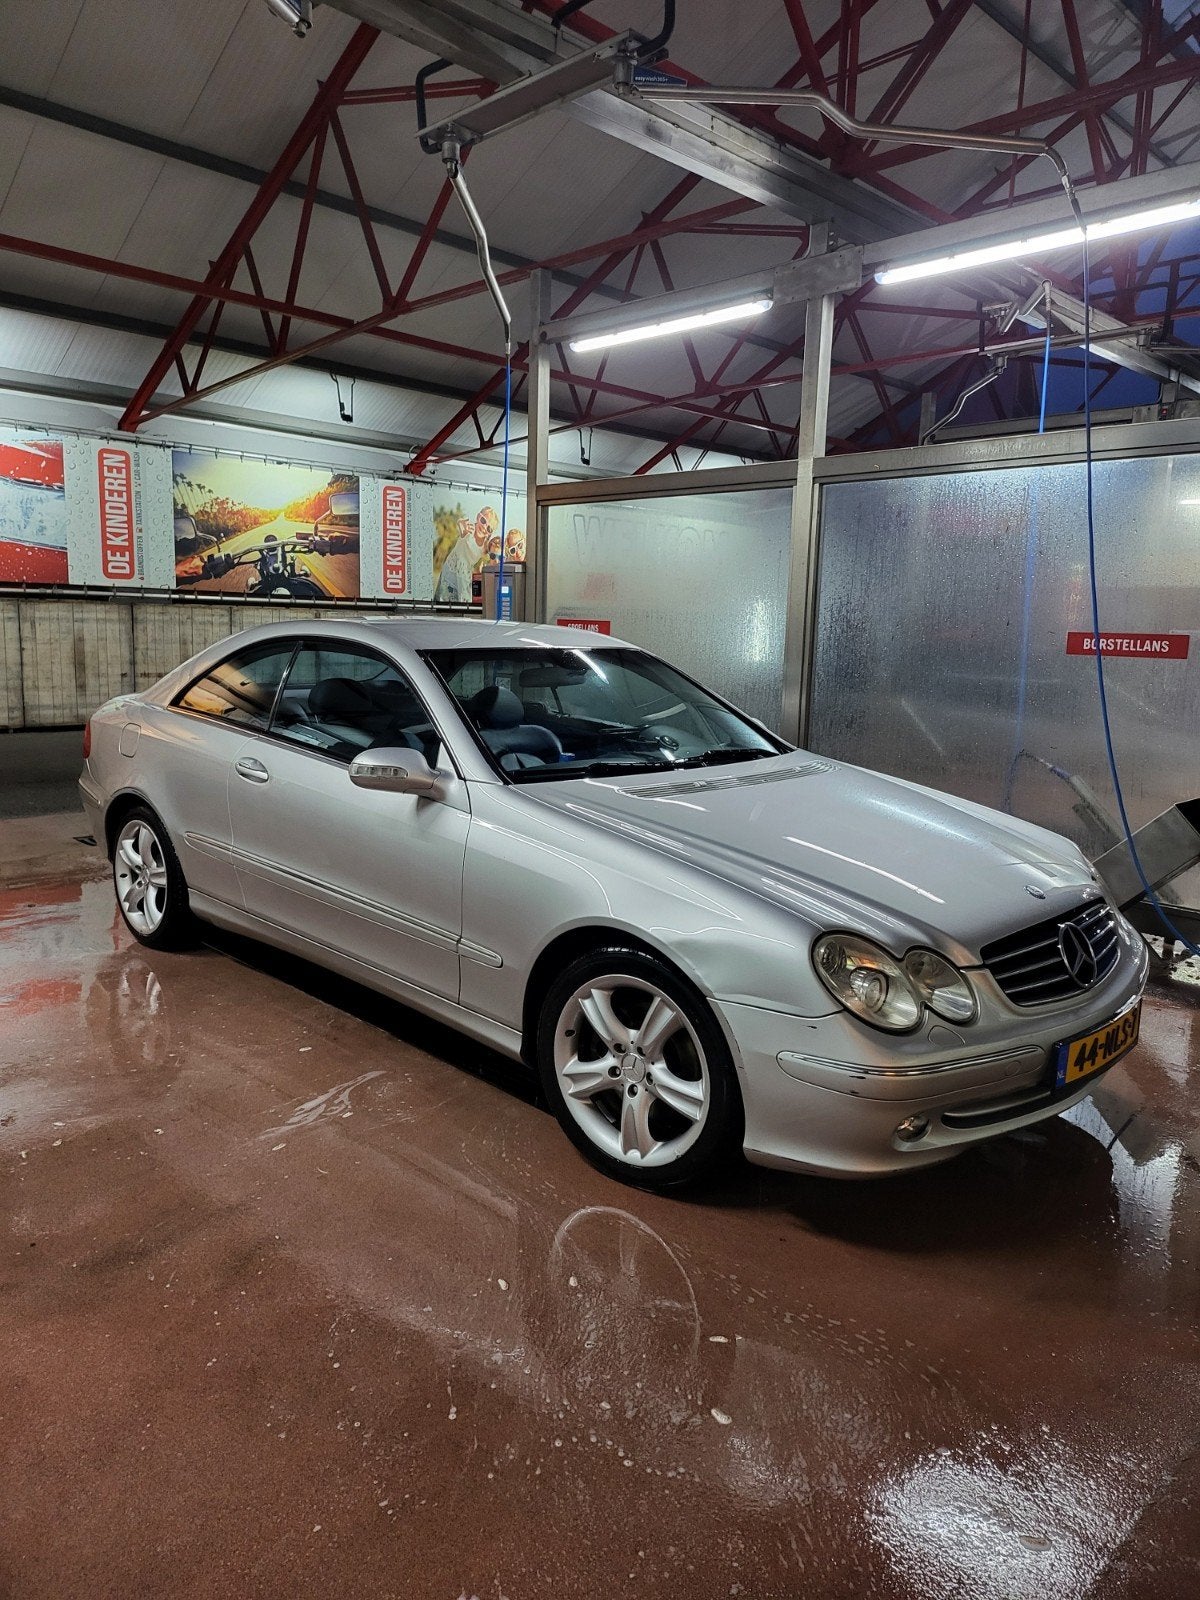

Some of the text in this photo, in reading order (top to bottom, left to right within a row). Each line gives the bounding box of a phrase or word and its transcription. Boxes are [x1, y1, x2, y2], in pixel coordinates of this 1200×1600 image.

[103, 453, 130, 574] DE KINDEREN
[386, 490, 402, 589] DE KINDEREN
[1083, 638, 1170, 653] BORSTELLANS
